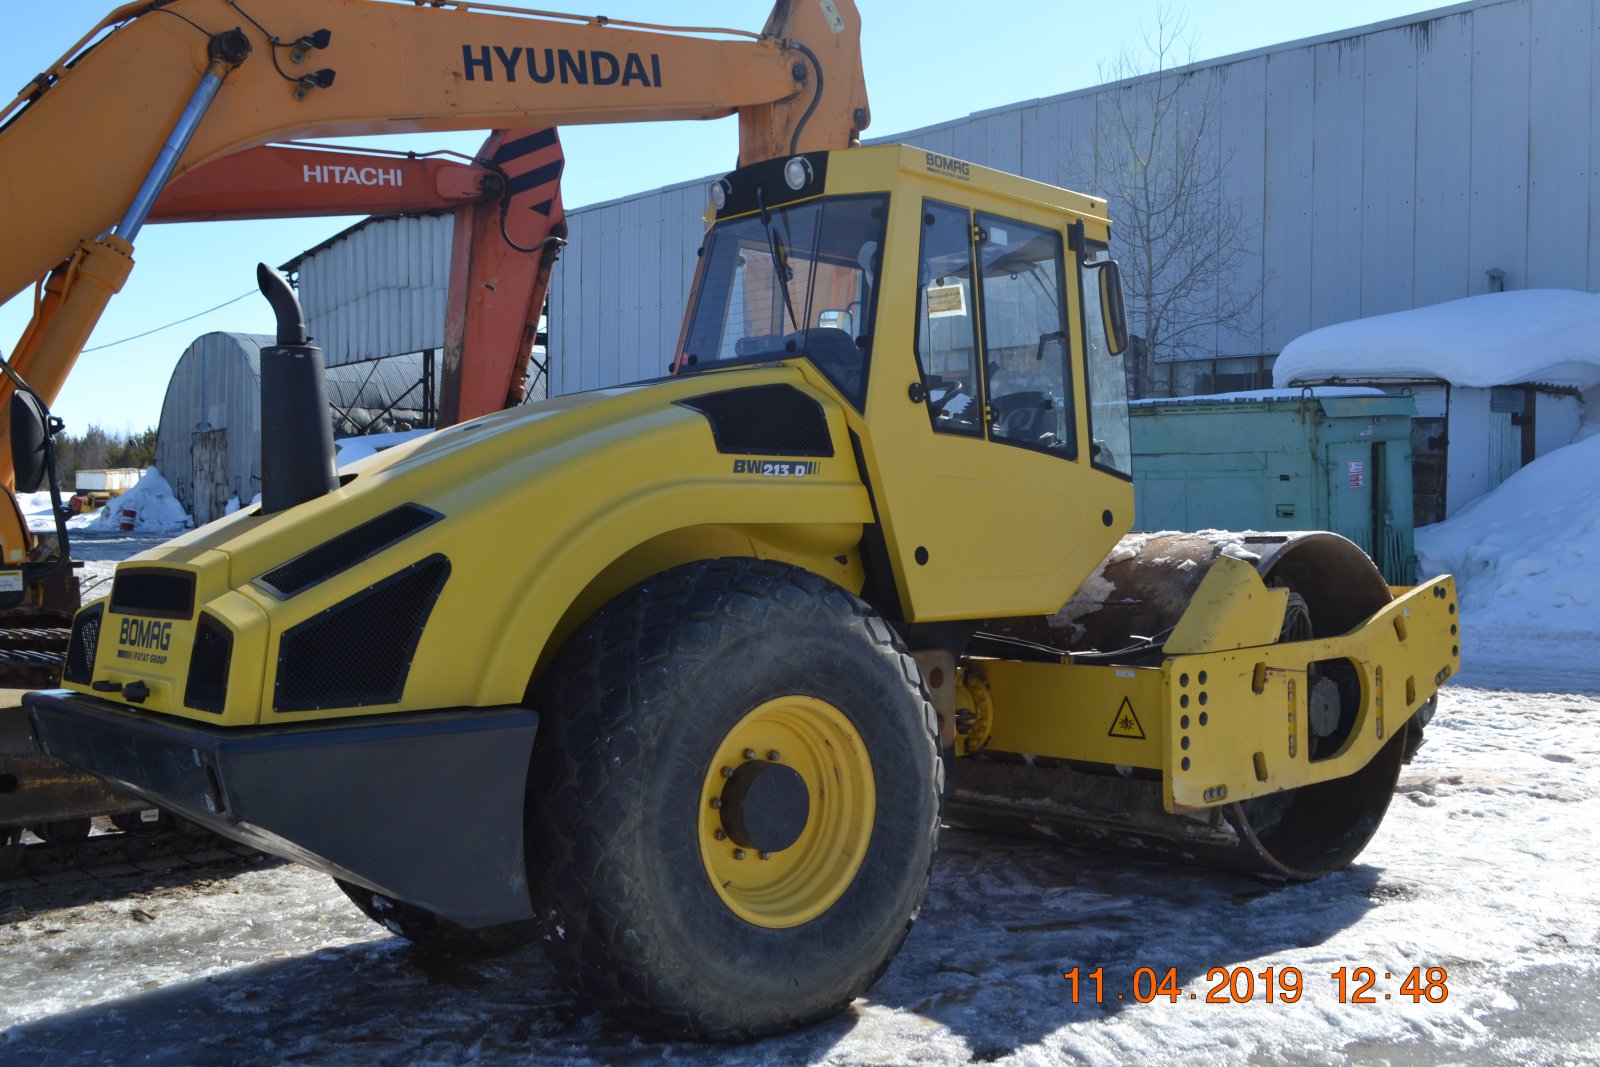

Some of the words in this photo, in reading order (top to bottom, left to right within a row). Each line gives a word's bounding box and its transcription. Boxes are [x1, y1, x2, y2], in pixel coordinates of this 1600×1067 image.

[462, 44, 662, 87] HYUNDAI
[303, 164, 403, 187] HITACHI
[926, 152, 970, 177] BOMAG
[119, 617, 172, 651] BOMAG
